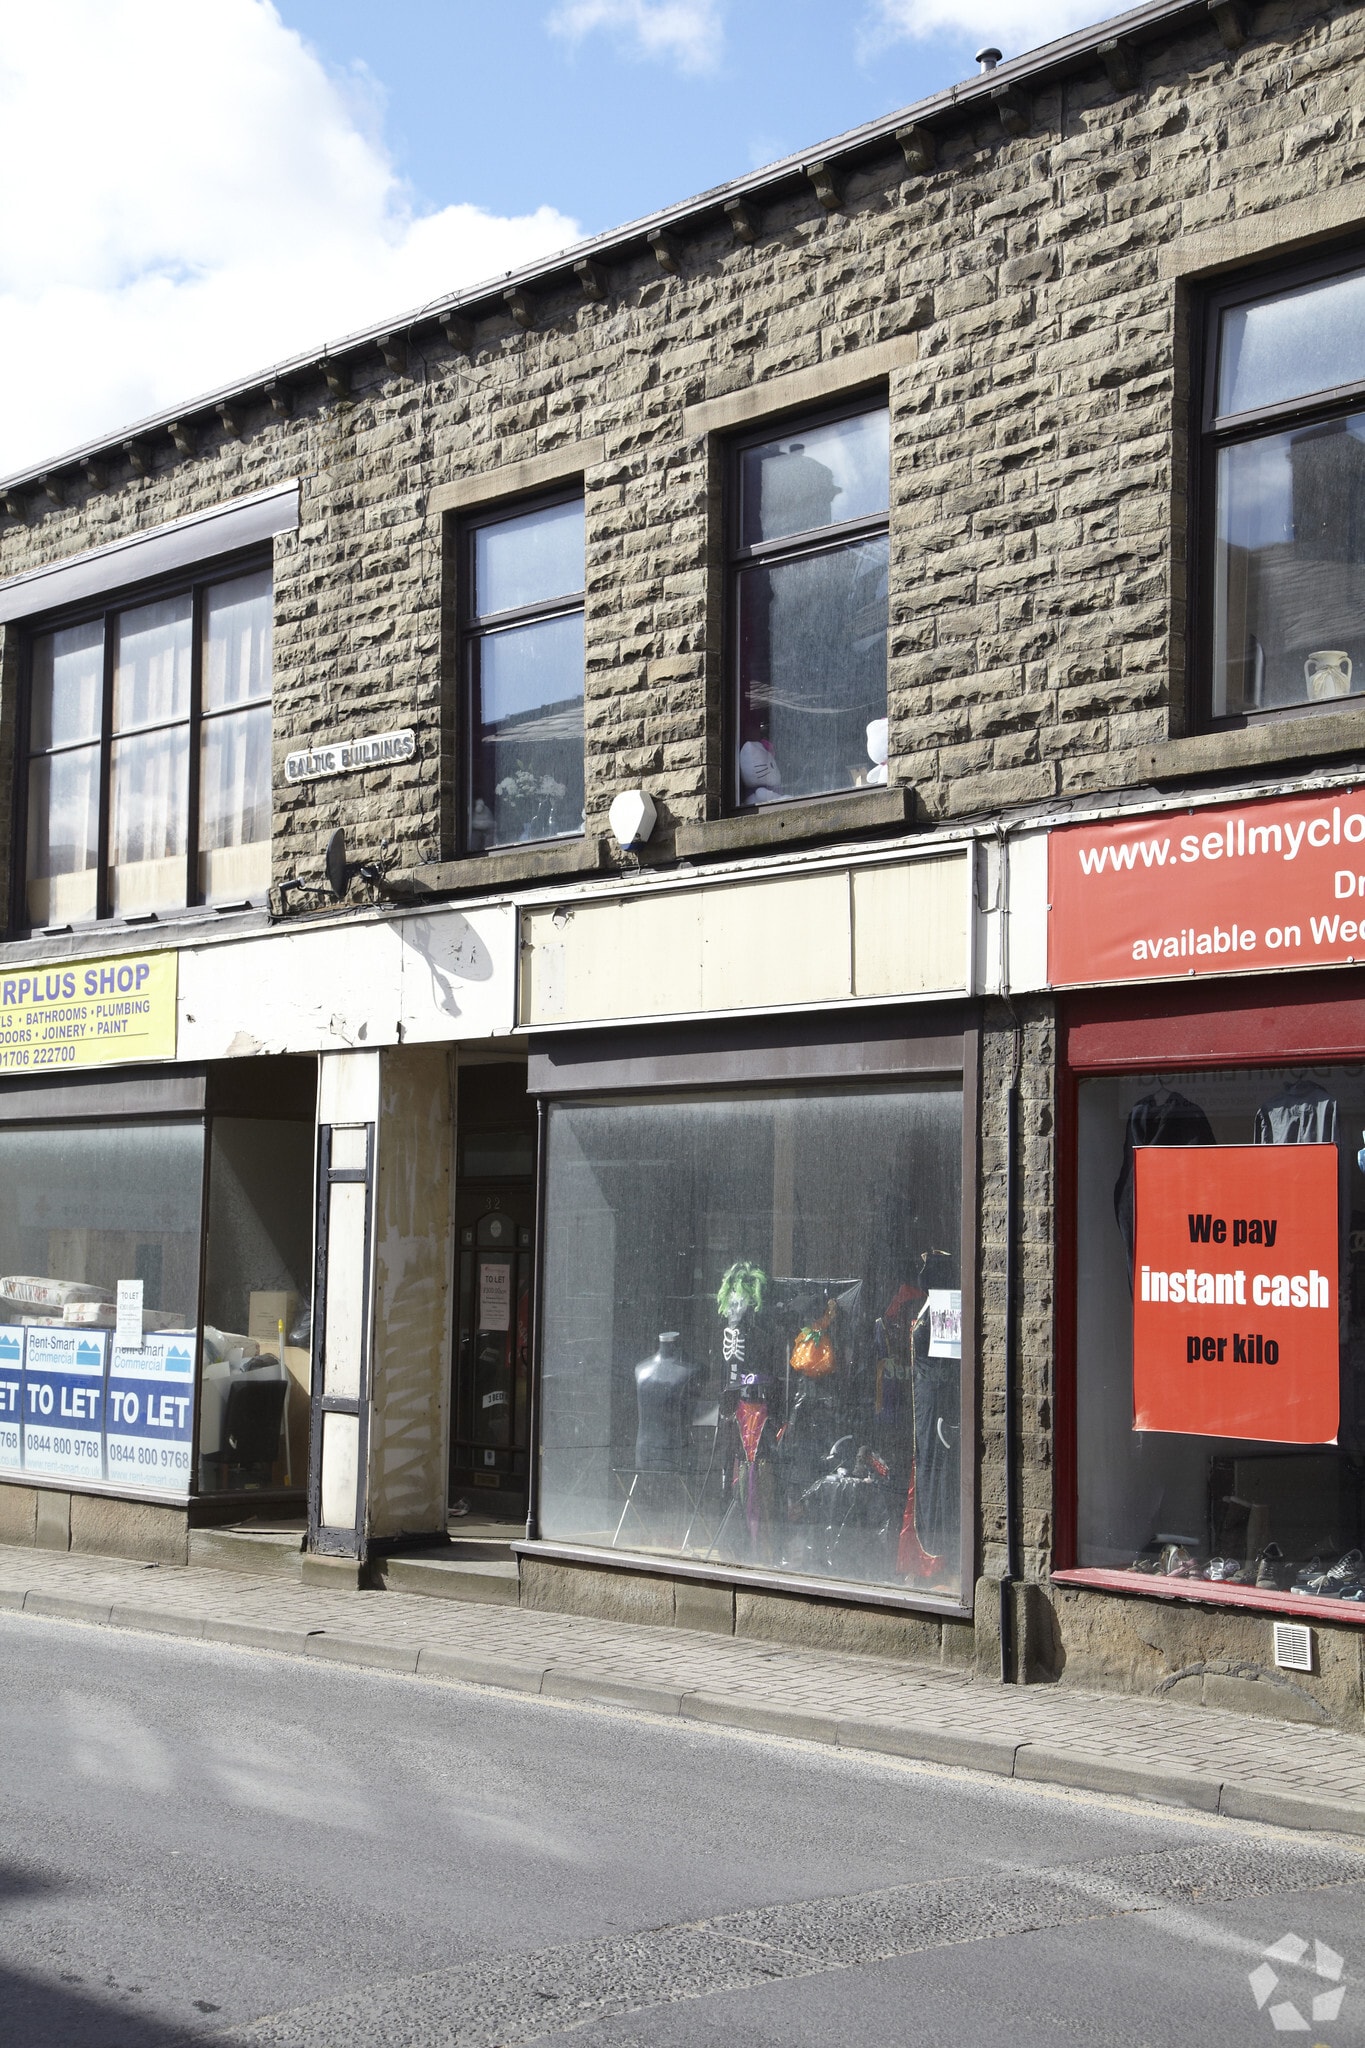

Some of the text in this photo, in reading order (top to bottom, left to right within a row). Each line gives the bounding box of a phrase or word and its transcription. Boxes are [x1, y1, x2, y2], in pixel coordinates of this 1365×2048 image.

[288, 736, 415, 778] BALTIC BUILDINGS
[1132, 924, 1257, 961] available
[1264, 925, 1301, 949] on
[84, 963, 150, 997] SHOP
[26, 1006, 87, 1026] BATHROOMS
[96, 1000, 150, 1018] PLUMBING
[42, 1023, 87, 1040] JOINERY
[97, 1019, 129, 1035] PAINT
[33, 1045, 76, 1064] 222700
[1187, 1213, 1278, 1247] We pay
[1141, 1265, 1330, 1309] instant cash
[28, 1350, 75, 1366] Commercial
[29, 1334, 75, 1352] Rent-Smart
[1186, 1333, 1279, 1366] per kilo
[114, 1355, 163, 1372] Commercial
[27, 1383, 100, 1420] TO LET
[110, 1391, 190, 1429] TO LET
[27, 1434, 99, 1459] 0844 800 9768
[110, 1443, 190, 1470] 0844 800 9768
